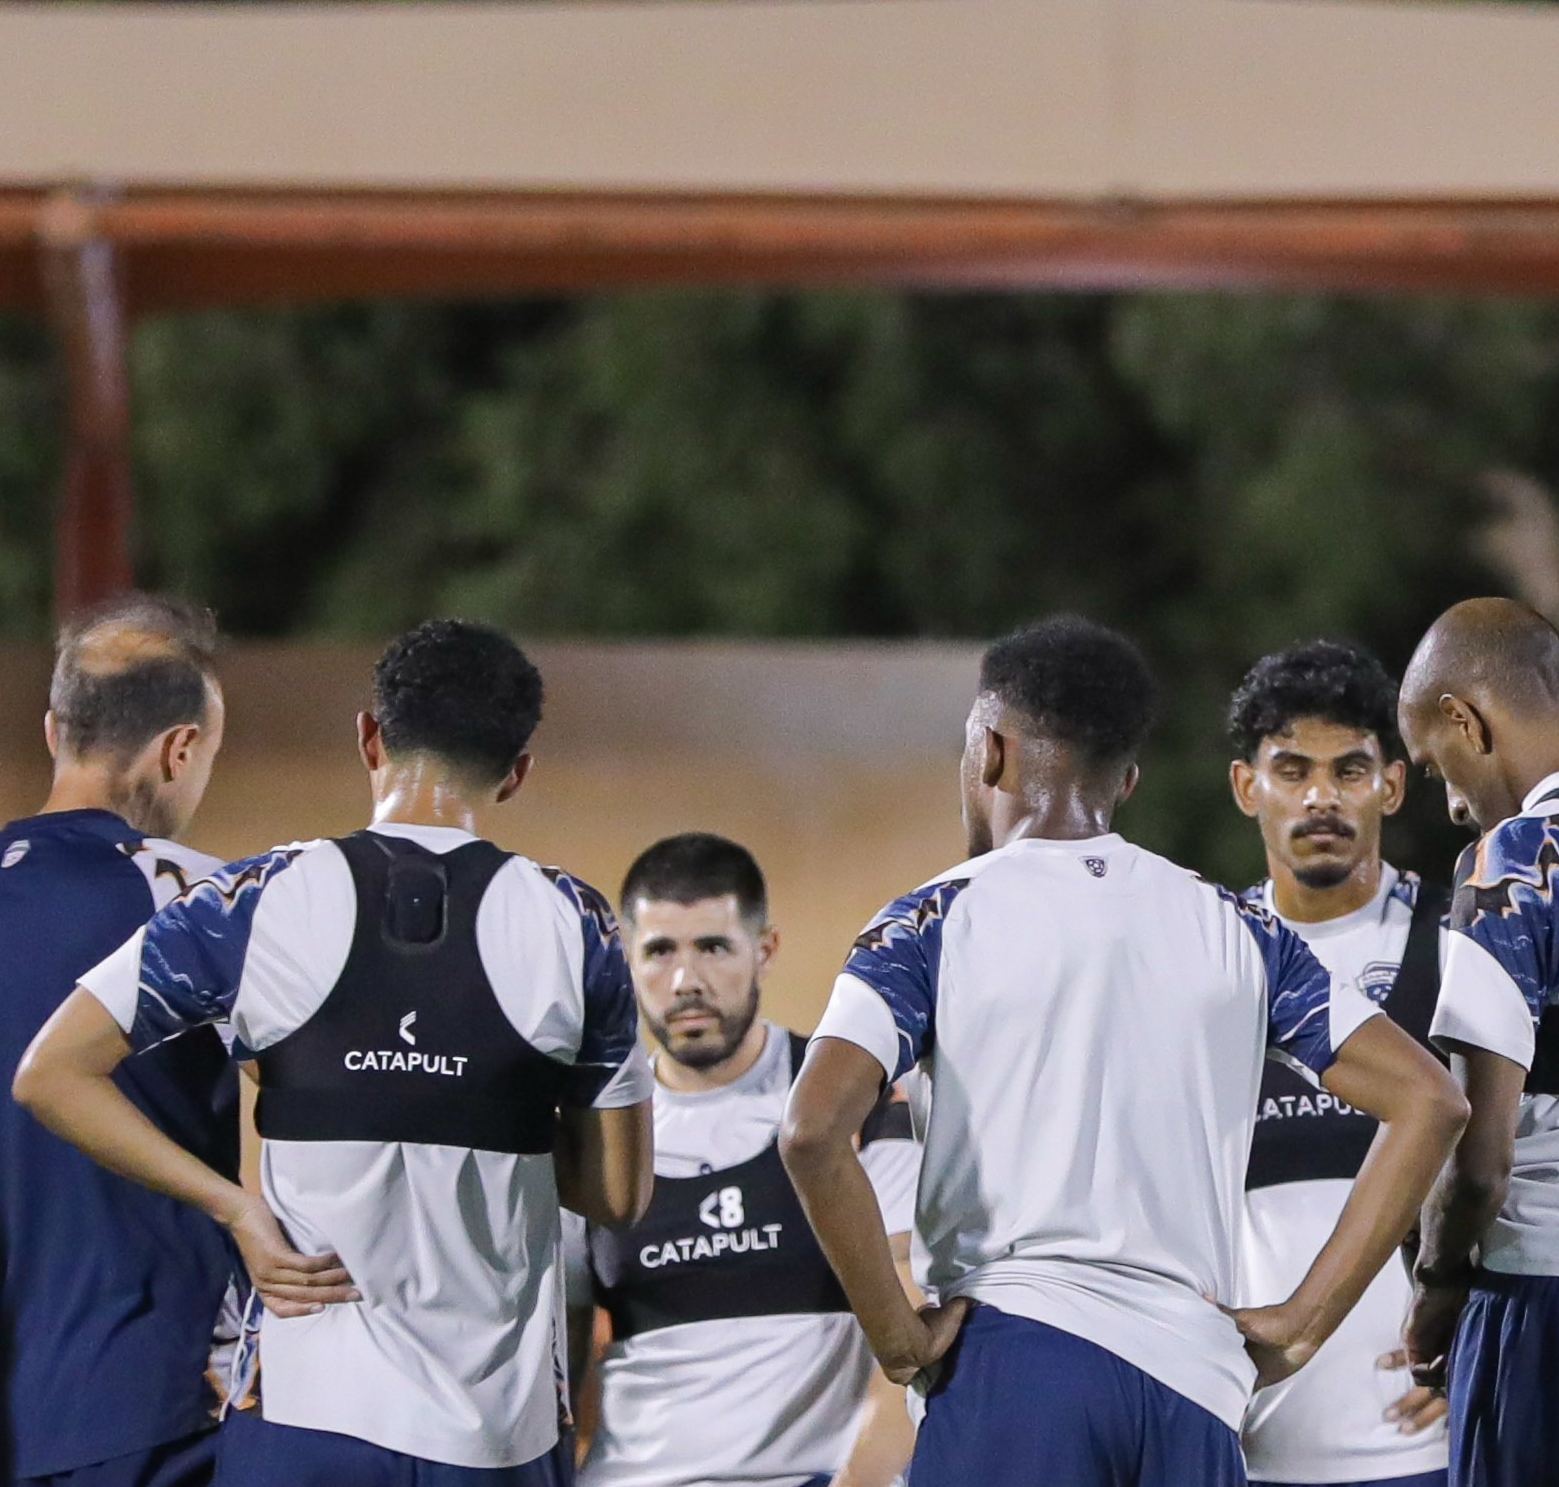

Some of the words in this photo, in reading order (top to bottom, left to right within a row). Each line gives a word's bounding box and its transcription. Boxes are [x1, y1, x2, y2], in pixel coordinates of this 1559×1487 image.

[344, 1050, 468, 1076] CATAPULT
[1246, 1094, 1366, 1121] ATAPU
[719, 1186, 744, 1228] 8
[640, 1223, 783, 1268] CATAPULT
